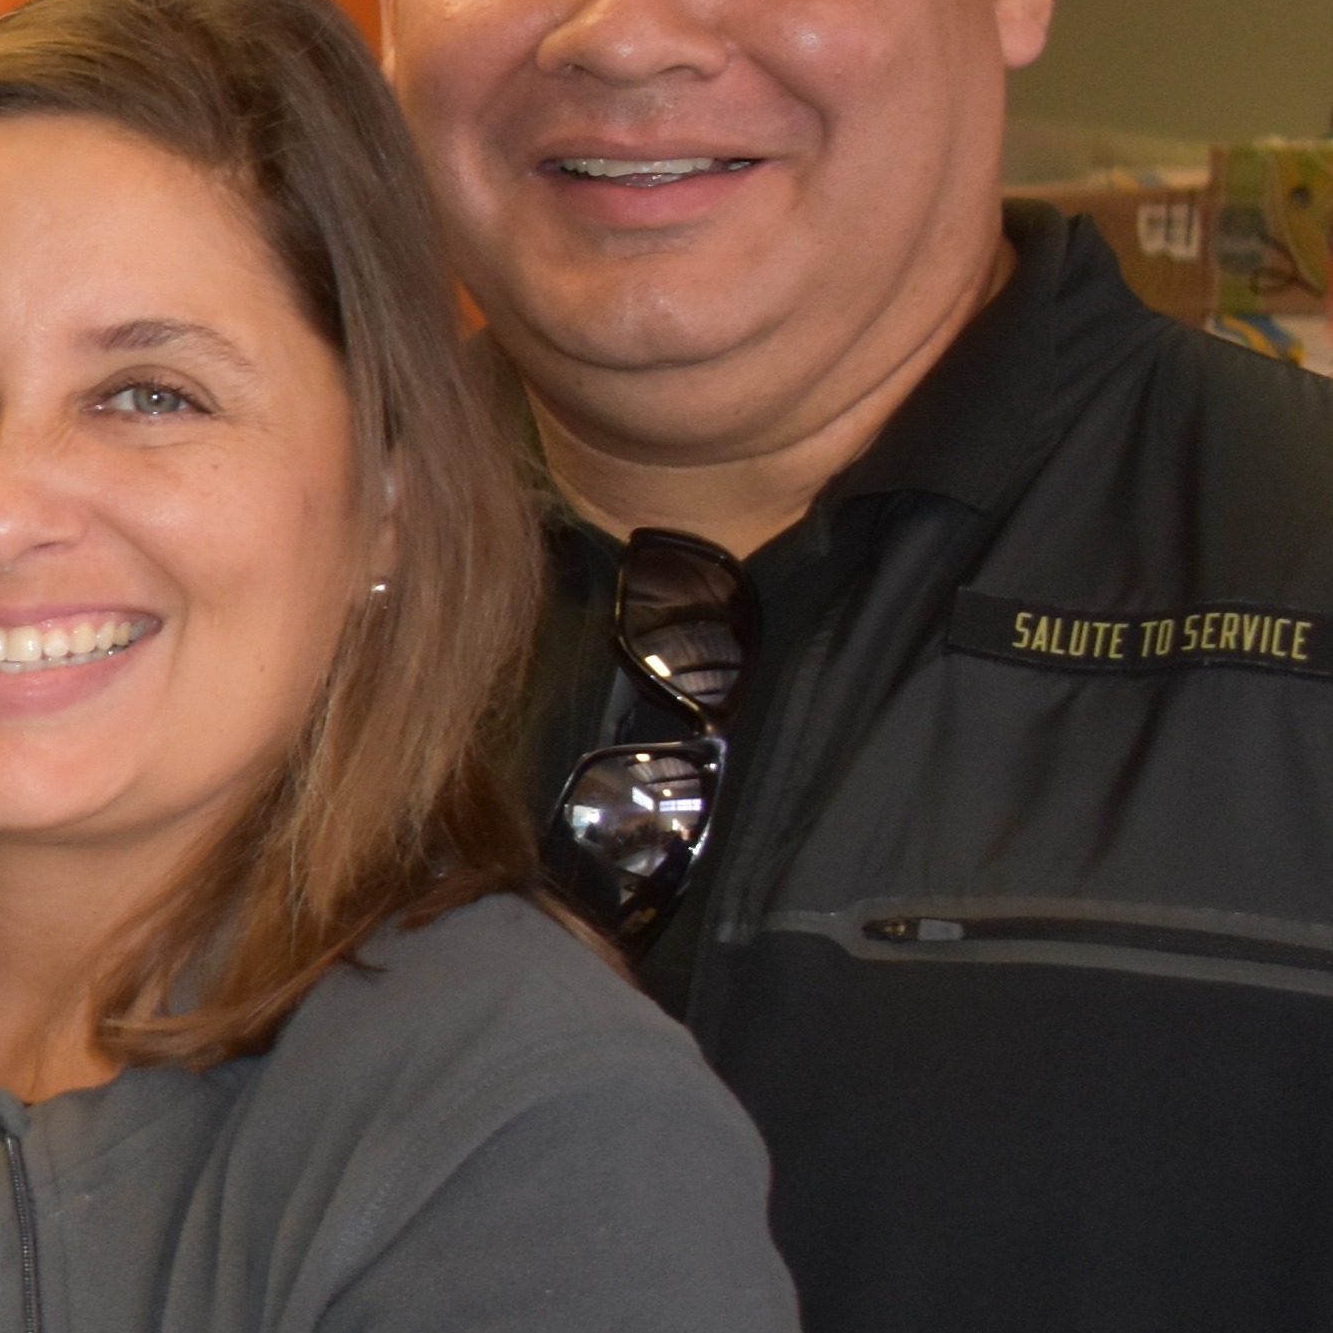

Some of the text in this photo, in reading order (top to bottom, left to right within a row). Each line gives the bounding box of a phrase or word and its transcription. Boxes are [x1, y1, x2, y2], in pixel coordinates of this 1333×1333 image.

[1012, 612, 1312, 660] SALUTE TO SERVICE
